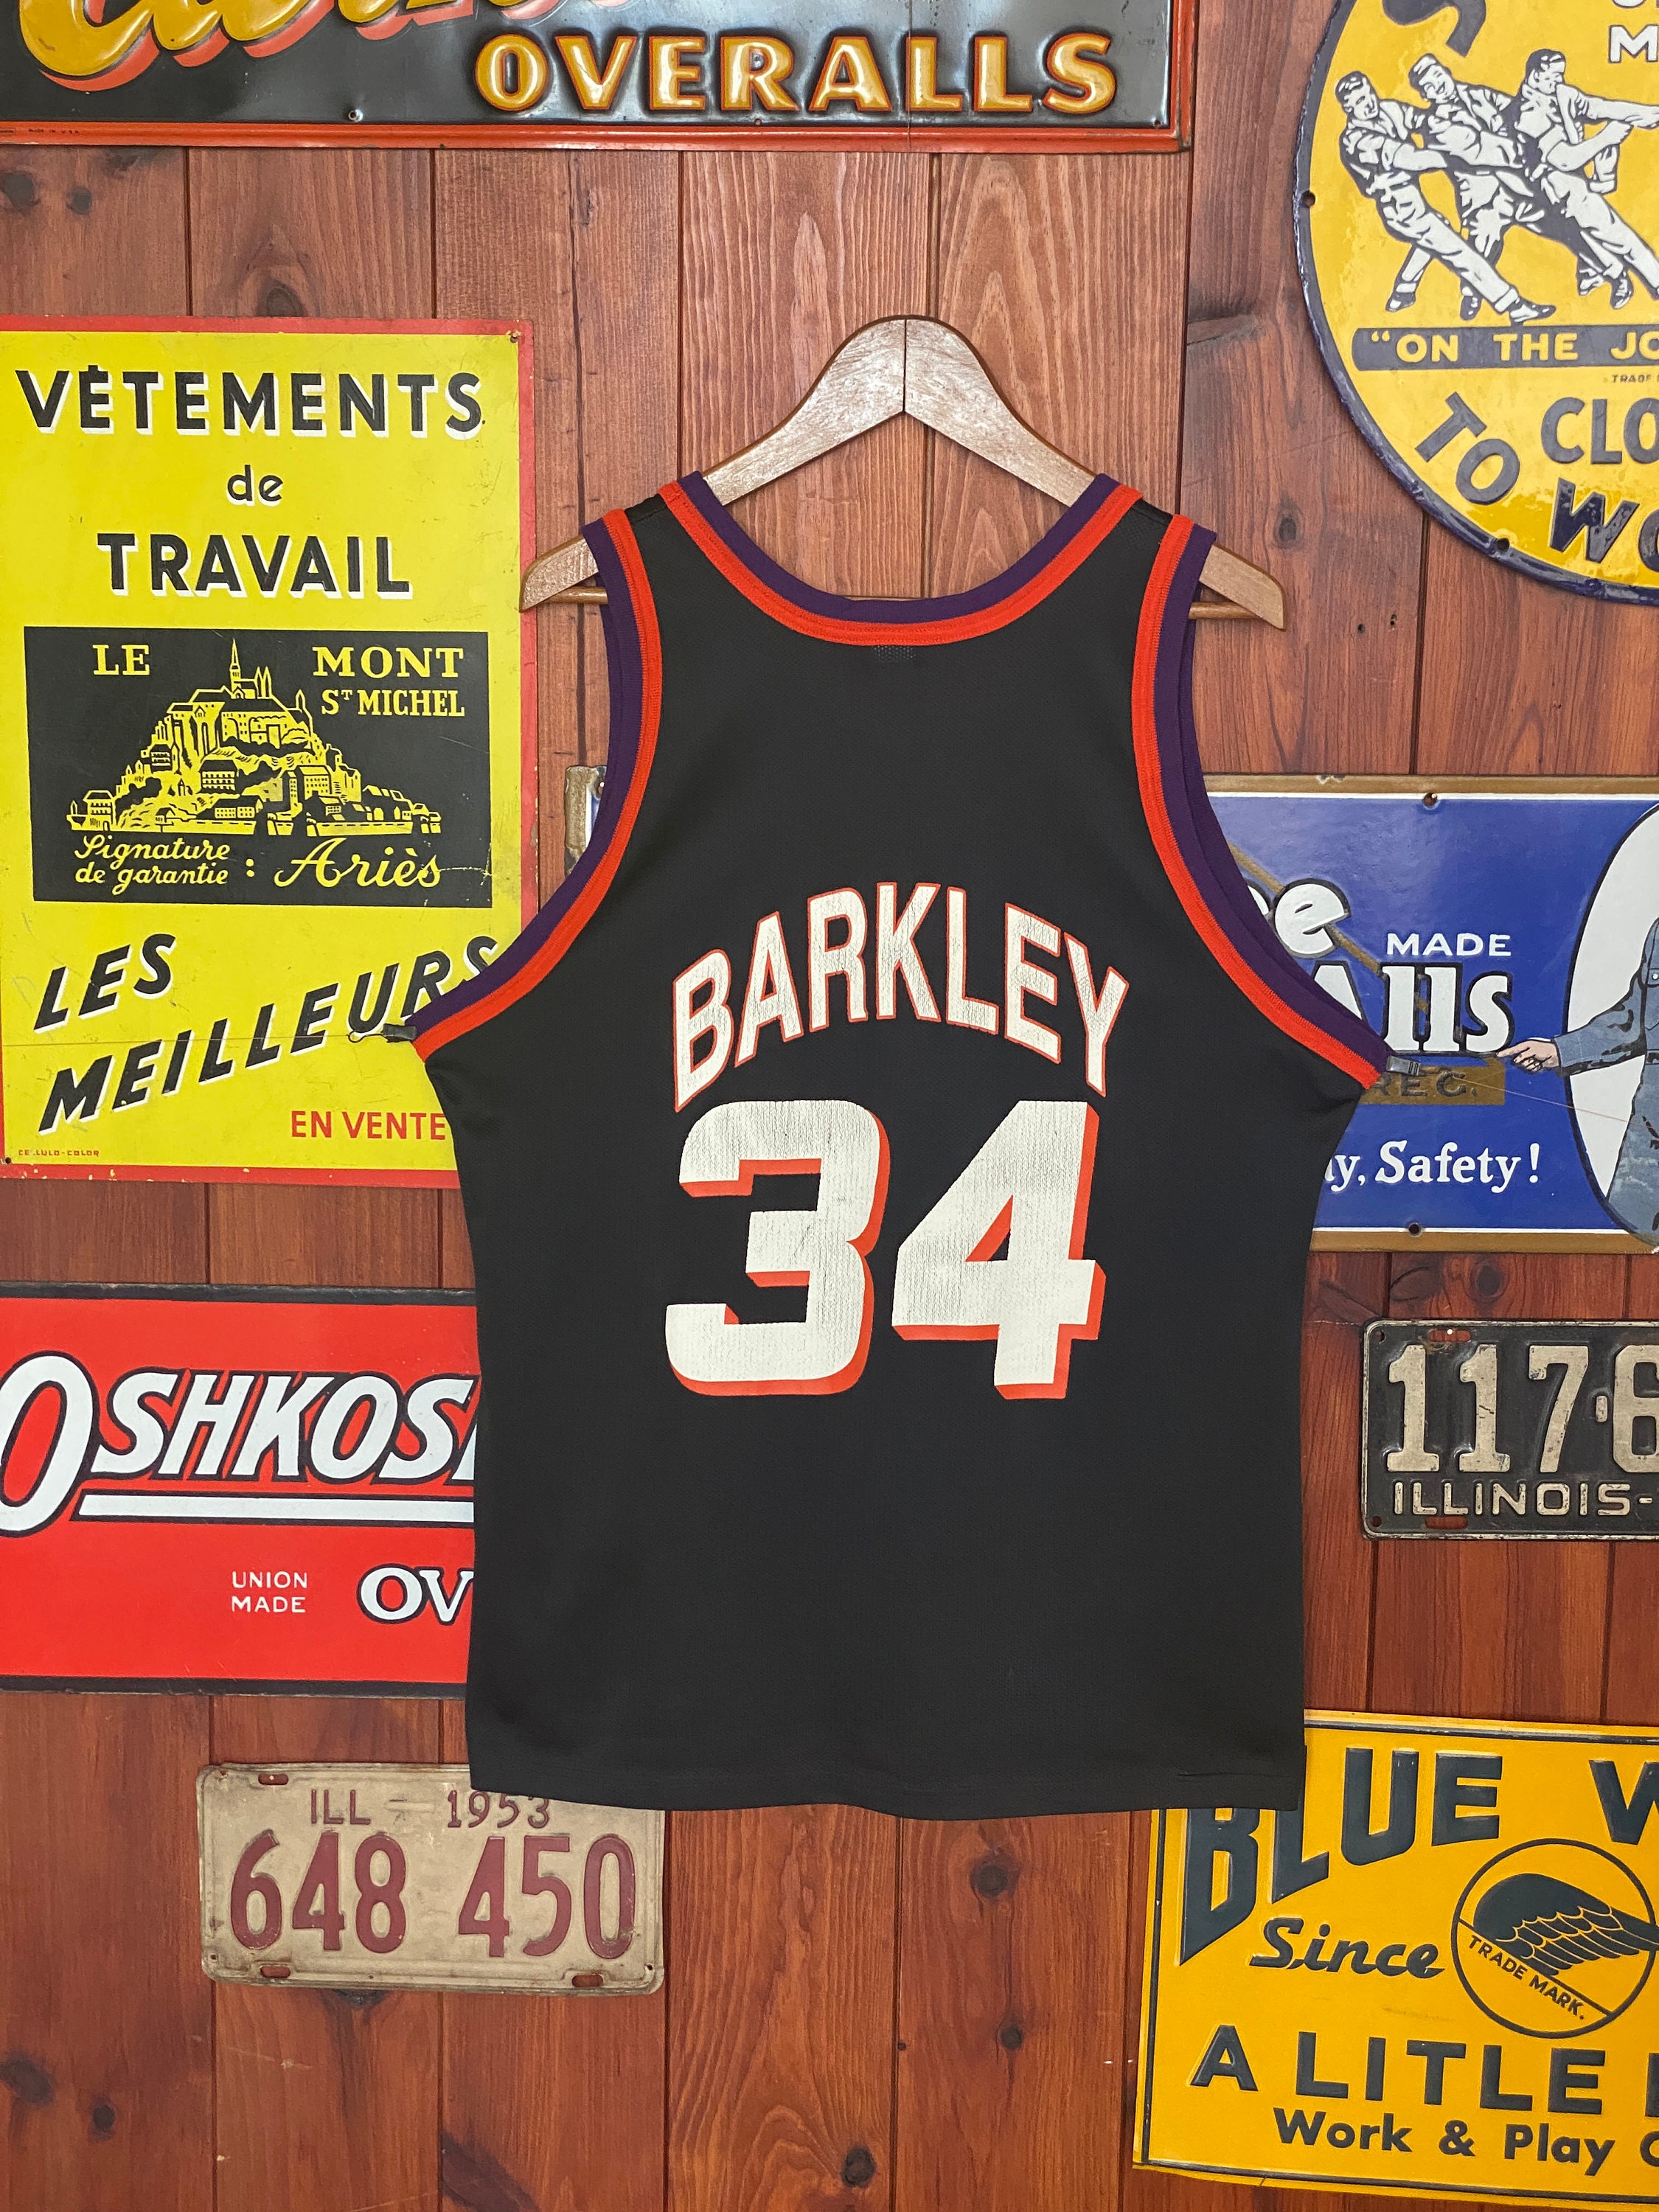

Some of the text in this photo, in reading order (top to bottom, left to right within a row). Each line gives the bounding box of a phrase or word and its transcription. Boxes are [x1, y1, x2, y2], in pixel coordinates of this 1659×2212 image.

[475, 34, 1118, 114] OVERALLS
[1494, 332, 1579, 362] THE
[1415, 392, 1522, 507] TO
[1541, 396, 1659, 465] CLO
[226, 465, 284, 506] de
[97, 532, 413, 599] TRAVAIL
[93, 644, 465, 678] LE MONT
[357, 689, 465, 717] MICHEL
[74, 834, 231, 869] Signature
[74, 861, 229, 896] de garantie
[274, 837, 441, 888] Ariès
[1246, 877, 1350, 959] e
[1385, 933, 1512, 958] MADE
[33, 933, 176, 1033] LES
[672, 881, 1130, 1113] BARKLEY
[291, 1110, 446, 1141] EN VENTE
[664, 1099, 1107, 1399] 34
[230, 1596, 307, 1614] MADE
[232, 1571, 309, 1590] UNION
[358, 1565, 474, 1624] OV
[310, 1789, 549, 1829] ILL 1953
[1180, 1747, 1503, 1966] BLUE
[230, 1829, 637, 1960] 648 450
[1249, 1916, 1446, 1980] Since
[1469, 1935, 1585, 2020] TRADE MARK.
[1190, 2024, 1259, 2092] A
[1294, 2031, 1607, 2115] LITLE
[1273, 2107, 1413, 2153] Work
[1438, 2118, 1476, 2157] &
[1503, 2123, 1615, 2177] Play
